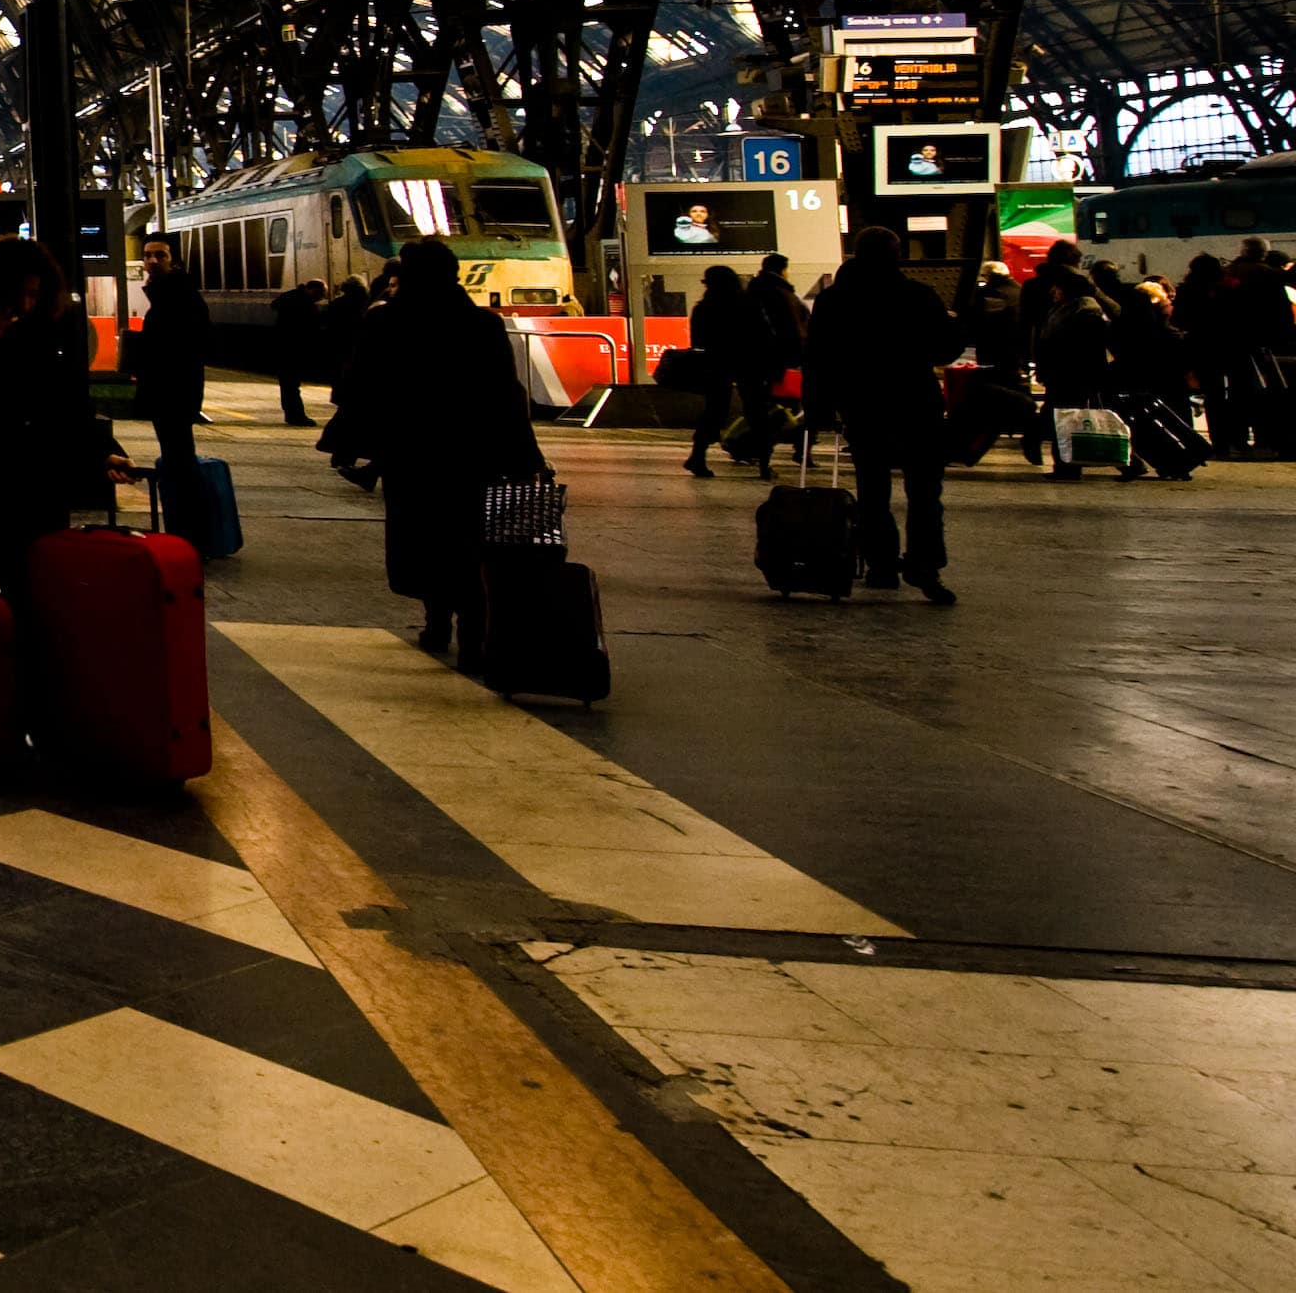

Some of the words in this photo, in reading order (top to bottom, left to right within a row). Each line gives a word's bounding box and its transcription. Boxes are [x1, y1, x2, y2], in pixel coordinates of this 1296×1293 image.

[846, 16, 891, 26] Smoking
[892, 17, 917, 25] area
[854, 62, 873, 75] 16
[753, 150, 792, 176] 16
[784, 189, 822, 211] 16
